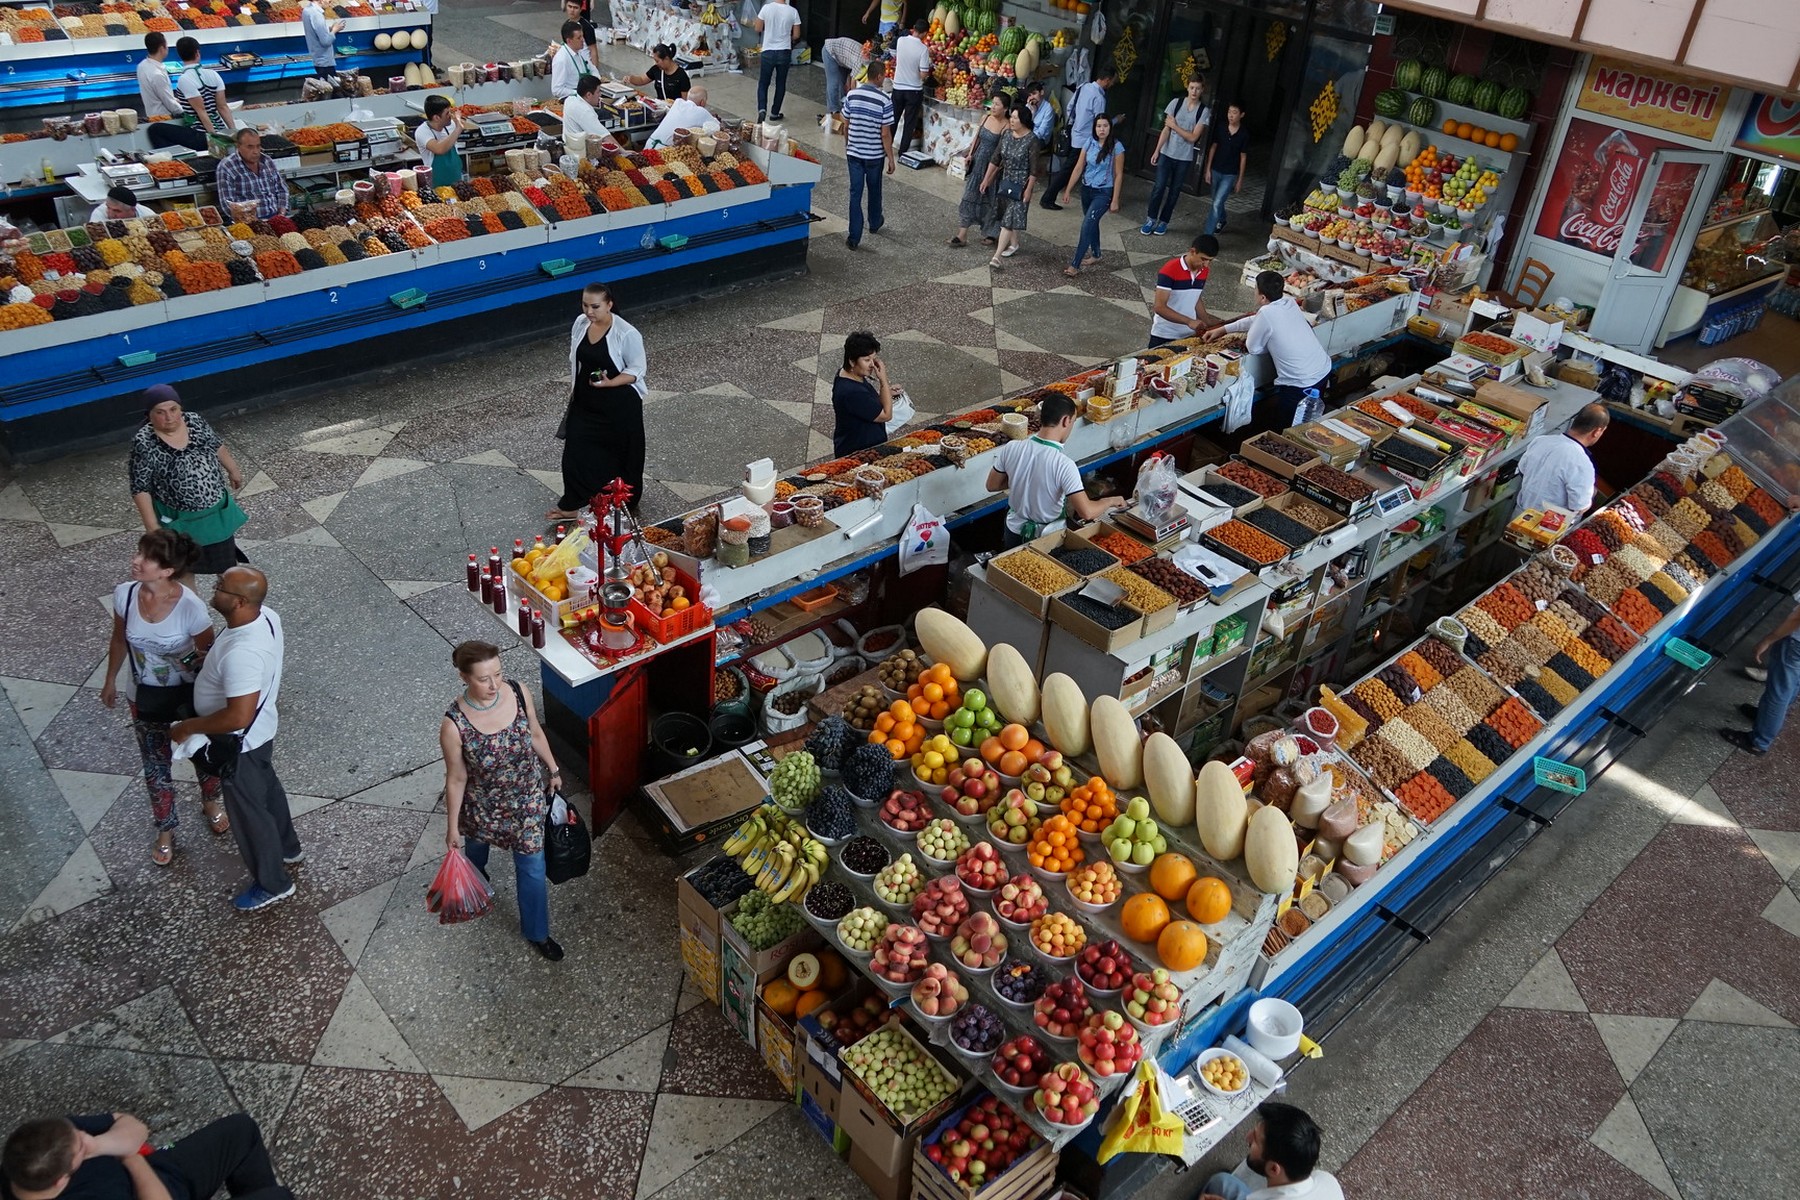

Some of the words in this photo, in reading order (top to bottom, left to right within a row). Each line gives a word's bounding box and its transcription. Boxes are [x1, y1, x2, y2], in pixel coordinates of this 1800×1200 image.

[126, 55, 132, 63] 3
[8, 66, 15, 75] 2
[1592, 66, 1722, 121] маркеті
[1600, 158, 1634, 223] Coca-Cola
[723, 208, 728, 218] 5
[1560, 212, 1629, 254] Coca-Co
[599, 236, 605, 245] 4
[479, 260, 486, 270] 3
[329, 291, 338, 303] 2
[123, 334, 131, 344] 1
[733, 814, 750, 825] Oro
[709, 821, 732, 835] Verde
